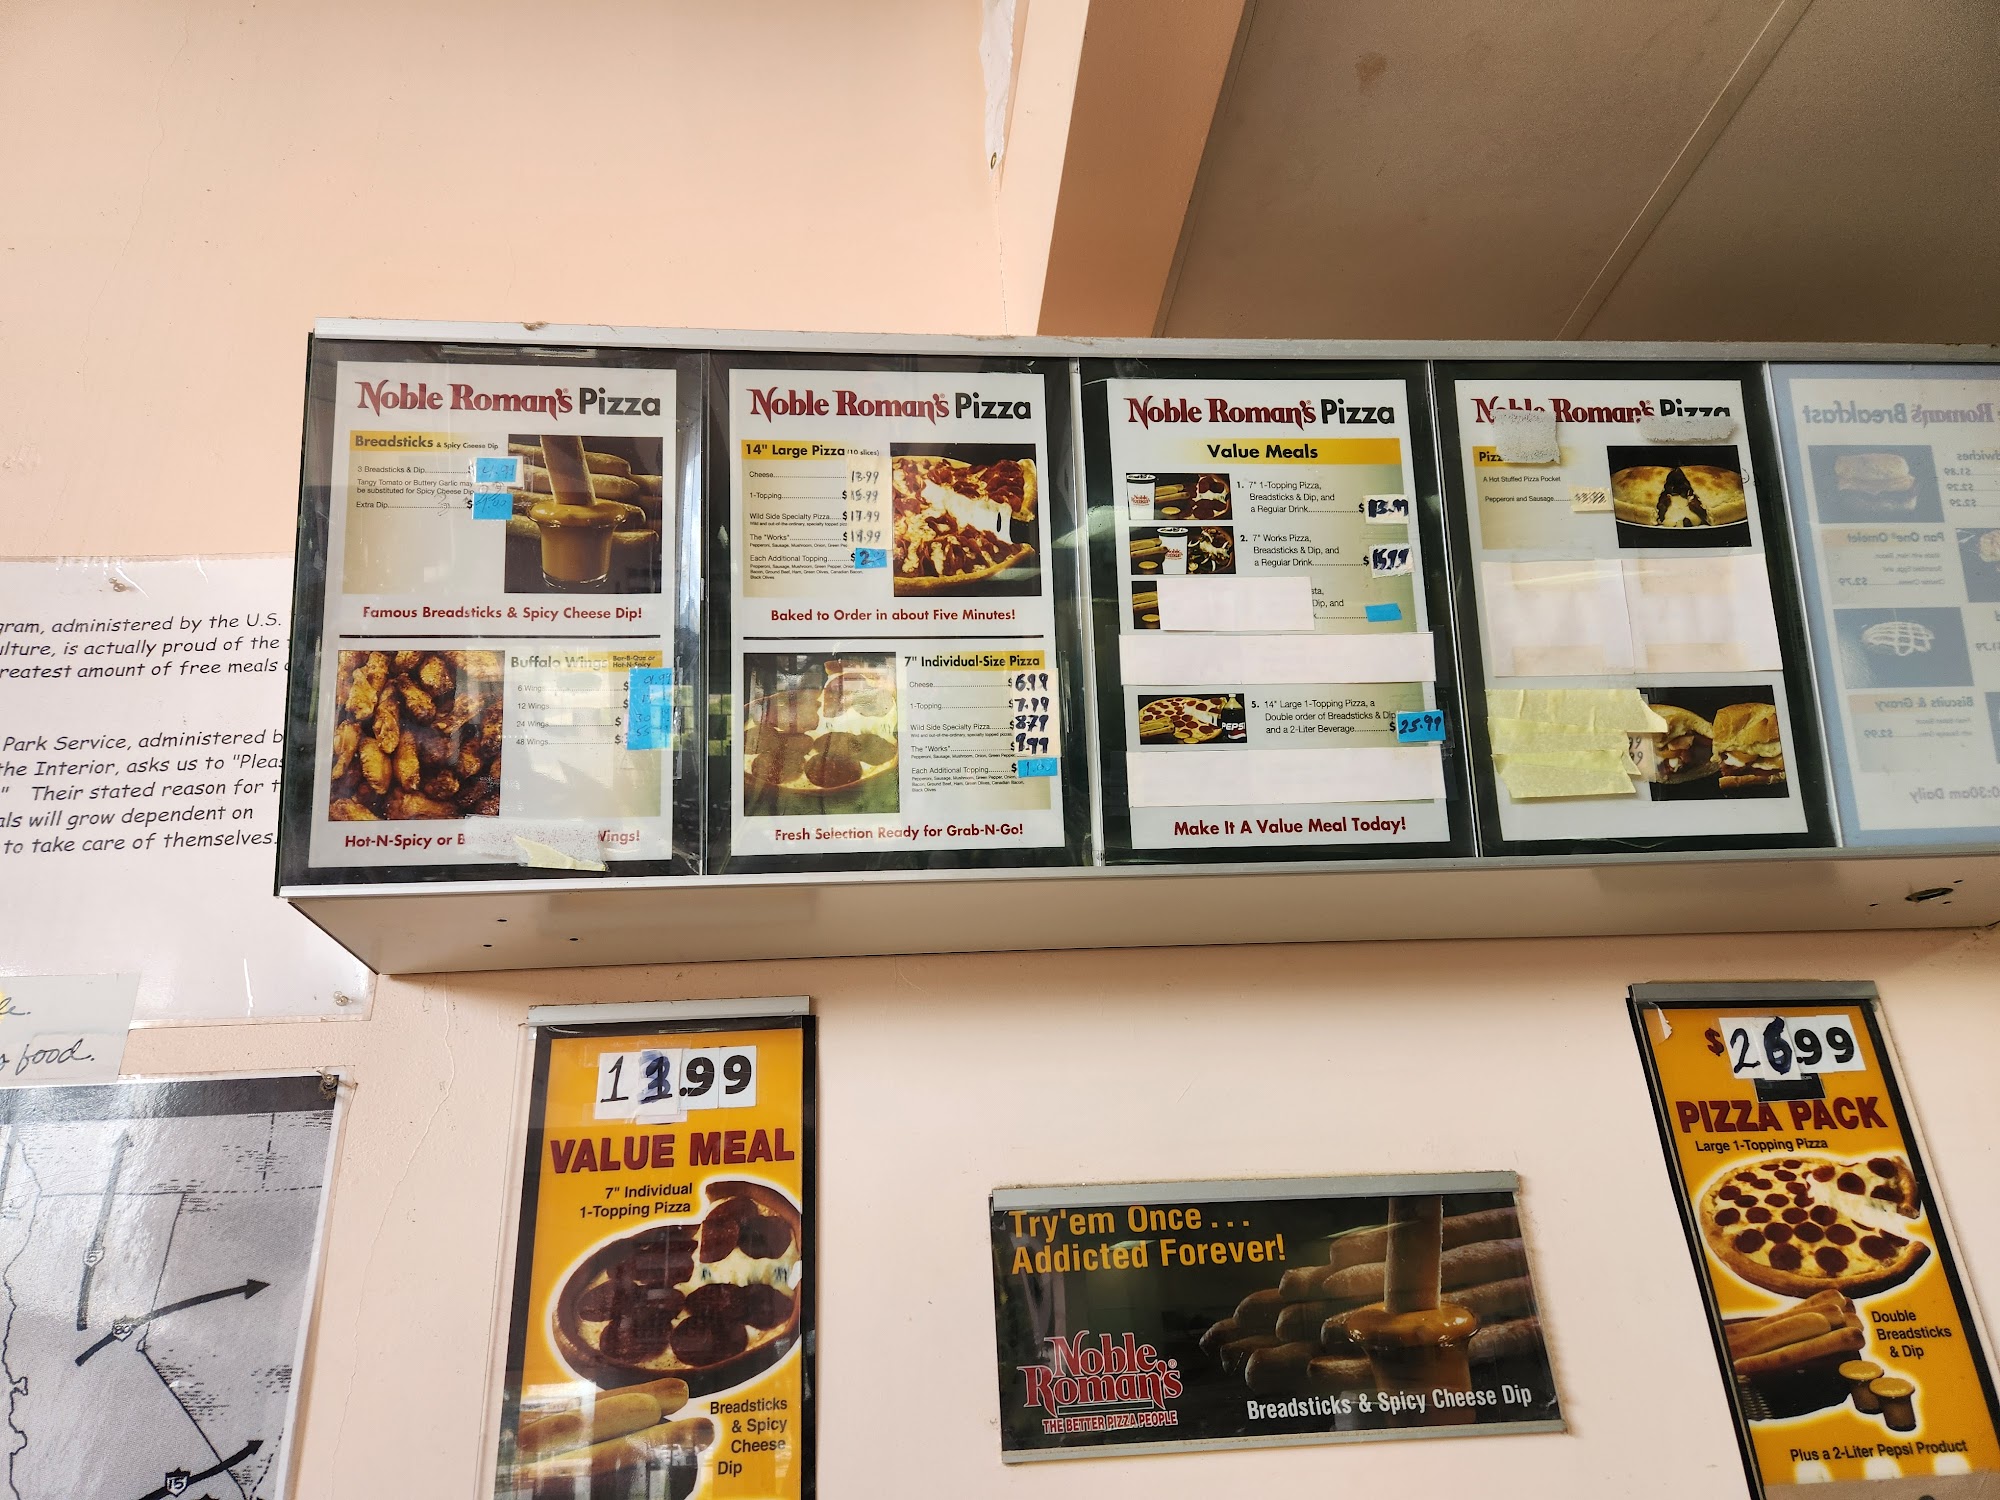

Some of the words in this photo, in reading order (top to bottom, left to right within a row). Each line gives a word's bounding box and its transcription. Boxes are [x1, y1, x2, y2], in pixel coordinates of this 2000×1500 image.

[354, 380, 443, 417] Noble
[450, 384, 574, 421] Roman's
[580, 388, 660, 416] Pizza
[746, 386, 829, 422] Noble
[832, 390, 950, 425] Roman's
[956, 393, 1031, 419] Pizza
[1124, 396, 1202, 430] Noble
[1204, 398, 1316, 430] Roman's
[1321, 398, 1395, 424] Pizza
[356, 436, 433, 448] Breadsticks
[746, 444, 768, 454] 14"
[772, 445, 808, 458] Large
[812, 446, 844, 456] Pizza
[1206, 444, 1260, 458] Value
[1266, 444, 1318, 458] Meals
[1260, 482, 1297, 491] 1-Topping
[1300, 482, 1322, 490] Pizza,
[782, 513, 811, 521] Specialty
[52, 616, 174, 634] administered
[180, 616, 202, 634] by
[209, 614, 240, 629] the
[247, 613, 282, 628] U.S.
[363, 606, 417, 618] Famous
[422, 606, 502, 619] Breadsticks
[508, 607, 517, 619] &
[523, 607, 559, 622] Spicy
[563, 607, 611, 620] Cheese
[616, 607, 642, 621] Dip!
[771, 610, 812, 621] Baked
[817, 610, 830, 621] to
[834, 610, 872, 621] Order
[876, 610, 888, 621] in
[892, 610, 930, 621] about
[933, 610, 958, 621] Five
[962, 609, 1016, 622] Minutes!
[63, 642, 77, 656] is
[84, 638, 156, 658] actually
[162, 637, 216, 658] proud
[223, 636, 244, 651] of
[251, 636, 280, 650] the
[77, 662, 144, 678] amount
[151, 661, 172, 676] of
[179, 660, 222, 674] free
[228, 658, 278, 673] meals
[511, 656, 560, 668] Buffalo
[565, 656, 608, 670] Wings
[904, 656, 916, 666] 7"
[922, 655, 1006, 666] Individual-Size
[1010, 655, 1040, 666] Pizza
[1399, 715, 1442, 734] 25.99
[4, 736, 48, 752] Park
[56, 734, 132, 751] Service,
[138, 730, 266, 748] administered
[34, 760, 120, 778] Interior,
[126, 758, 170, 774] asks
[177, 758, 198, 772] us
[205, 756, 224, 770] to
[32, 784, 84, 802] Their
[89, 782, 156, 800] stated
[161, 782, 226, 798] reason
[234, 779, 264, 795] for
[28, 810, 62, 828] will
[68, 812, 114, 831] grow
[122, 806, 226, 826] dependent
[232, 806, 254, 820] on
[1174, 821, 1220, 836] Make
[1224, 820, 1236, 835] It
[1240, 820, 1252, 834] A
[1256, 819, 1302, 834] Value
[1308, 818, 1347, 832] Meal
[1351, 816, 1406, 834] Today!
[4, 838, 24, 854] to
[32, 836, 75, 852] take
[82, 836, 126, 850] care
[133, 834, 156, 850] of
[164, 828, 278, 848] themselves.
[776, 828, 810, 840] Fresh
[816, 827, 873, 840] Selection
[878, 826, 920, 841] Ready
[924, 825, 942, 838] for
[947, 823, 1024, 837] Grab-N-Go!
[1704, 1027, 1724, 1056] $
[1730, 1016, 1854, 1076] 26.99
[15, 1038, 94, 1076] food.
[1676, 1100, 1783, 1134] PIZZA
[1789, 1096, 1888, 1132] PACK
[550, 1134, 675, 1174] VALUE
[689, 1128, 795, 1167] MEAL
[1696, 1140, 1730, 1154] Large
[1733, 1139, 1794, 1153] 1-Topping
[1796, 1138, 1828, 1150] Pizza
[605, 1186, 620, 1199] 7"
[624, 1182, 692, 1198] Individual
[580, 1204, 650, 1219] 1-Topping
[654, 1202, 691, 1214] Pizza
[1009, 1207, 1115, 1244] Try'em
[1128, 1204, 1202, 1234] Once
[1012, 1239, 1148, 1275] Addicted
[1161, 1233, 1287, 1269] Forever!
[1871, 1310, 1916, 1323] Double
[1877, 1326, 1952, 1341] Breadsticks
[1044, 1330, 1157, 1378] Noble
[1890, 1346, 1900, 1358] &
[1902, 1345, 1924, 1360] Dip
[1017, 1360, 1184, 1418] Roman's
[710, 1398, 788, 1415] Breadsticks
[1246, 1394, 1352, 1421] Breadsticks
[1358, 1392, 1372, 1414] &
[1377, 1391, 1426, 1416] Spicy
[1432, 1386, 1498, 1410] Cheese
[1502, 1384, 1532, 1407] Dip
[732, 1421, 742, 1434] &
[746, 1418, 788, 1434] Spicy
[1043, 1420, 1064, 1434] THE
[1065, 1415, 1105, 1432] BETTER
[1107, 1413, 1136, 1430] PIZZA
[1138, 1410, 1178, 1428] PEOPLE
[730, 1438, 786, 1454] Cheese
[1790, 1447, 1820, 1462] Plus
[1822, 1450, 1832, 1460] a
[1832, 1446, 1874, 1460] 2-Liter
[1877, 1444, 1914, 1458] Pepsi
[1916, 1440, 1968, 1454] Product
[718, 1460, 742, 1478] Dip
[167, 1476, 187, 1490] 15
